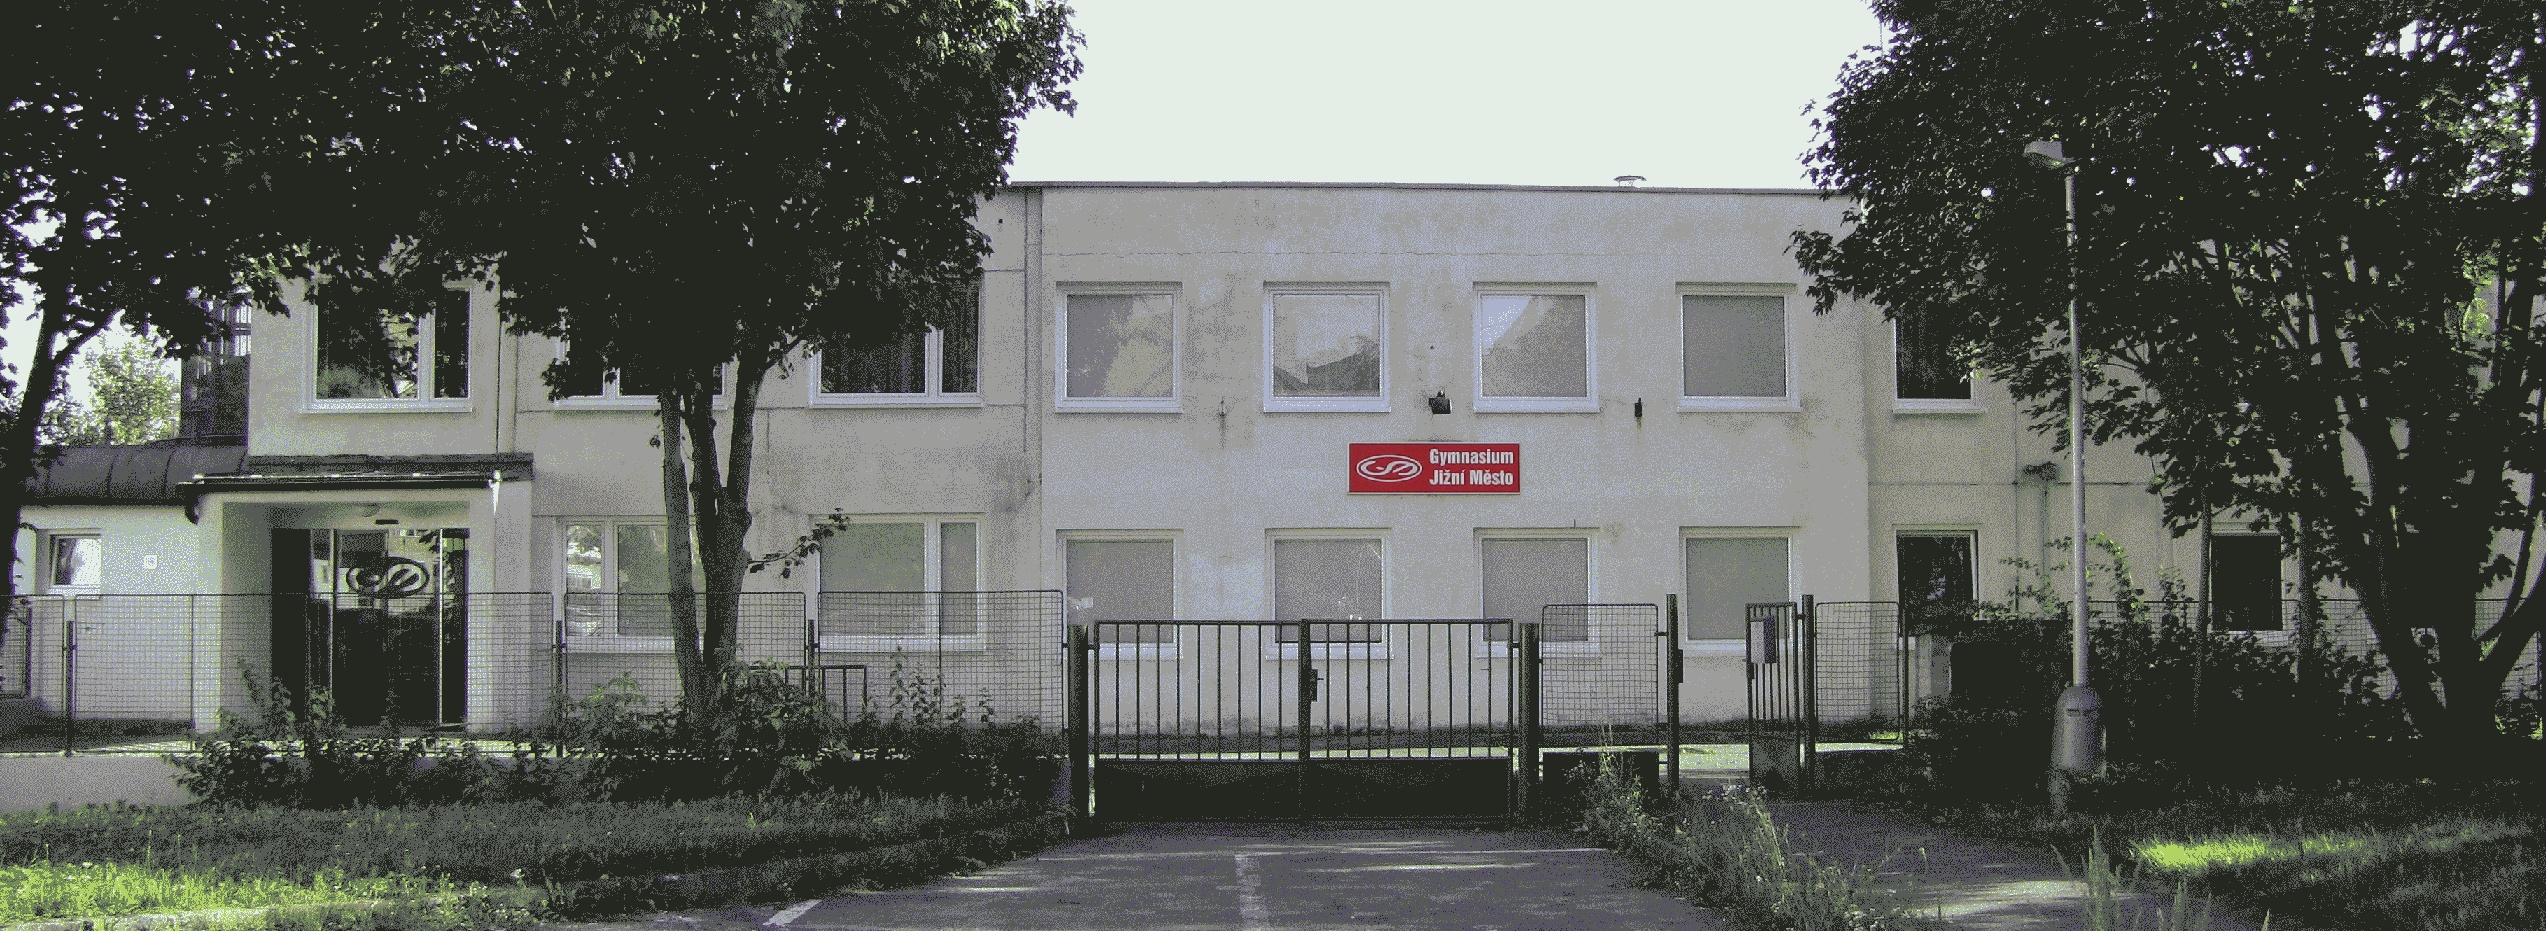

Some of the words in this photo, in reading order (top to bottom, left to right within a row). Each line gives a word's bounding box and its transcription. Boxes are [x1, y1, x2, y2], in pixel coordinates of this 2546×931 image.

[1429, 448, 1514, 466] Gymnasium
[1429, 469, 1465, 485] Jižní
[1469, 469, 1514, 485] Město
